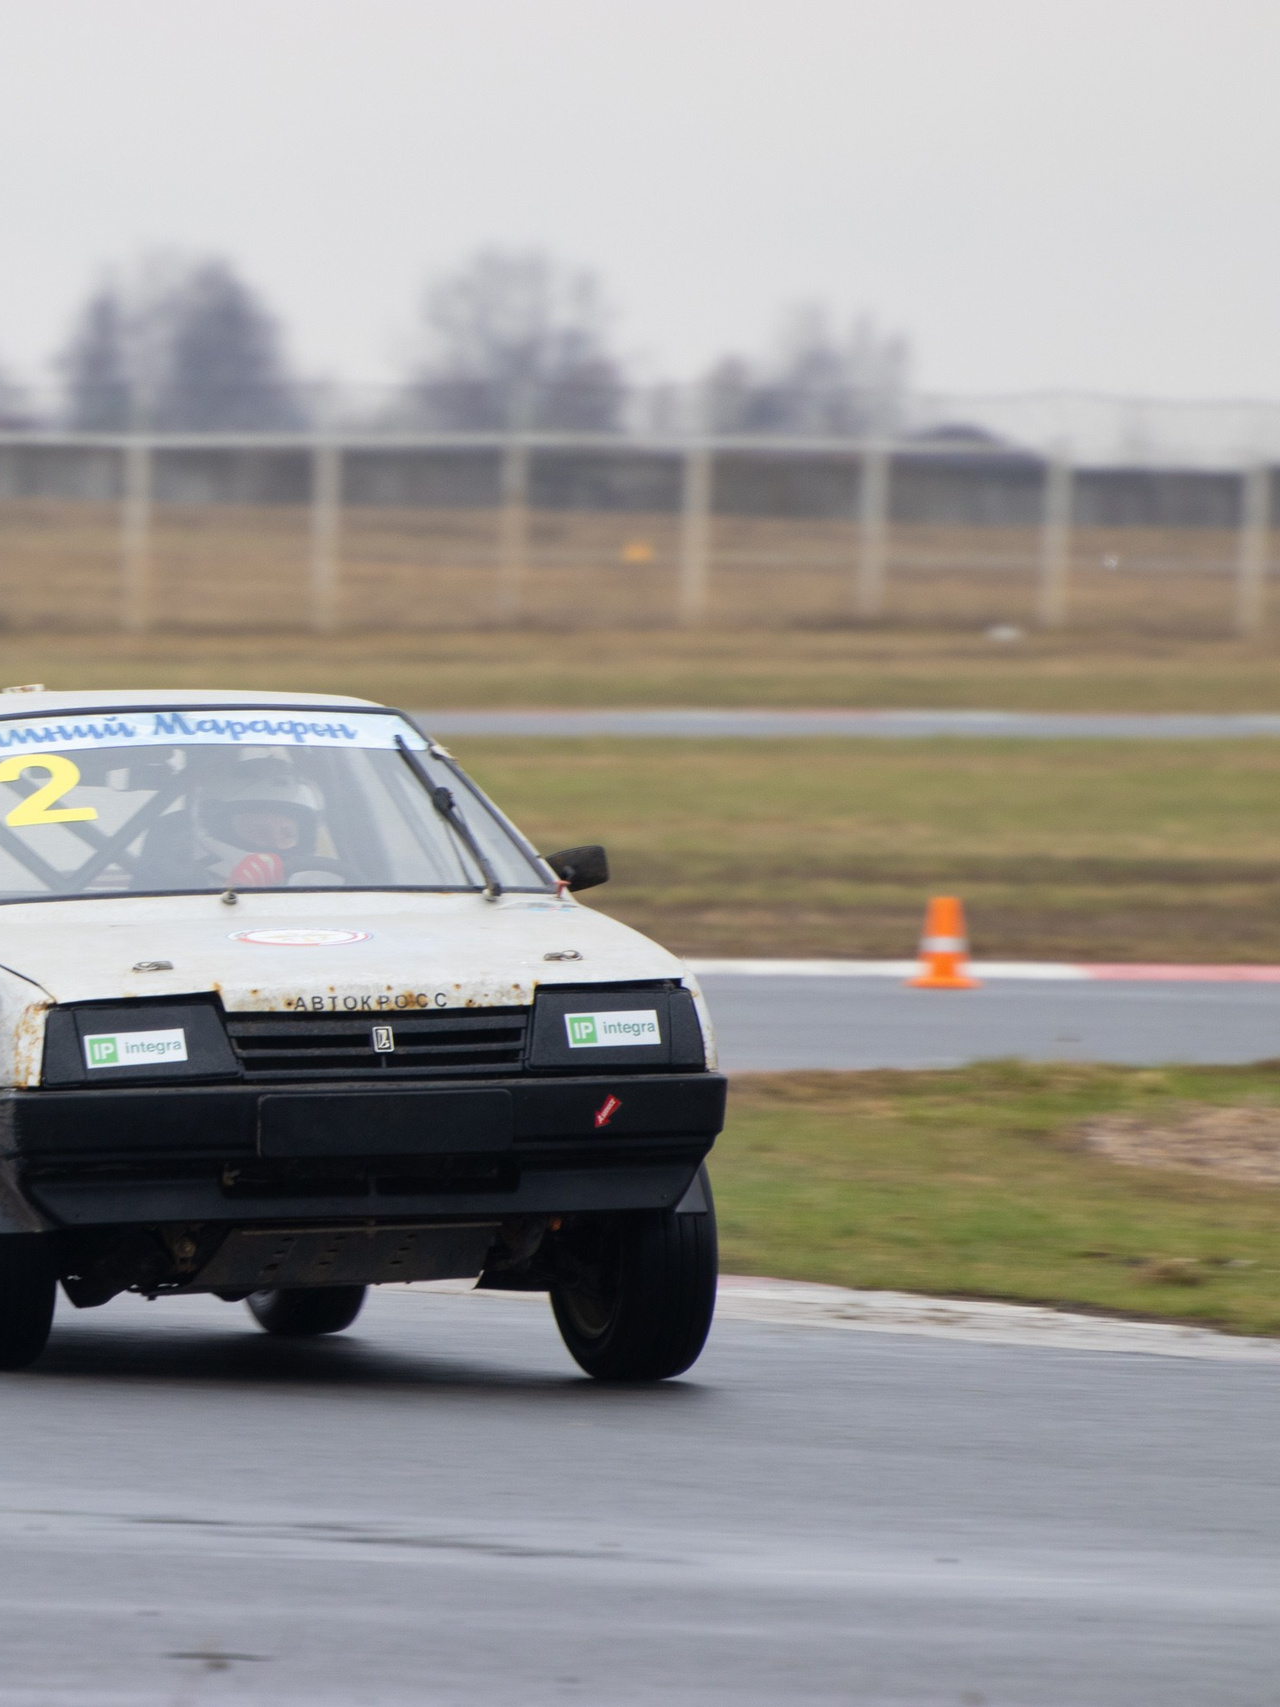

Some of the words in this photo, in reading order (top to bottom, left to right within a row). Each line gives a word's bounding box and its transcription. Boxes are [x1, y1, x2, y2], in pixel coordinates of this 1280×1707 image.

[151, 713, 358, 742] Марафон
[294, 992, 448, 1011] АВТОКРОСС
[572, 1021, 594, 1040] IP
[602, 1021, 656, 1037] integra
[91, 1041, 115, 1061] IP
[124, 1040, 182, 1055] integra
